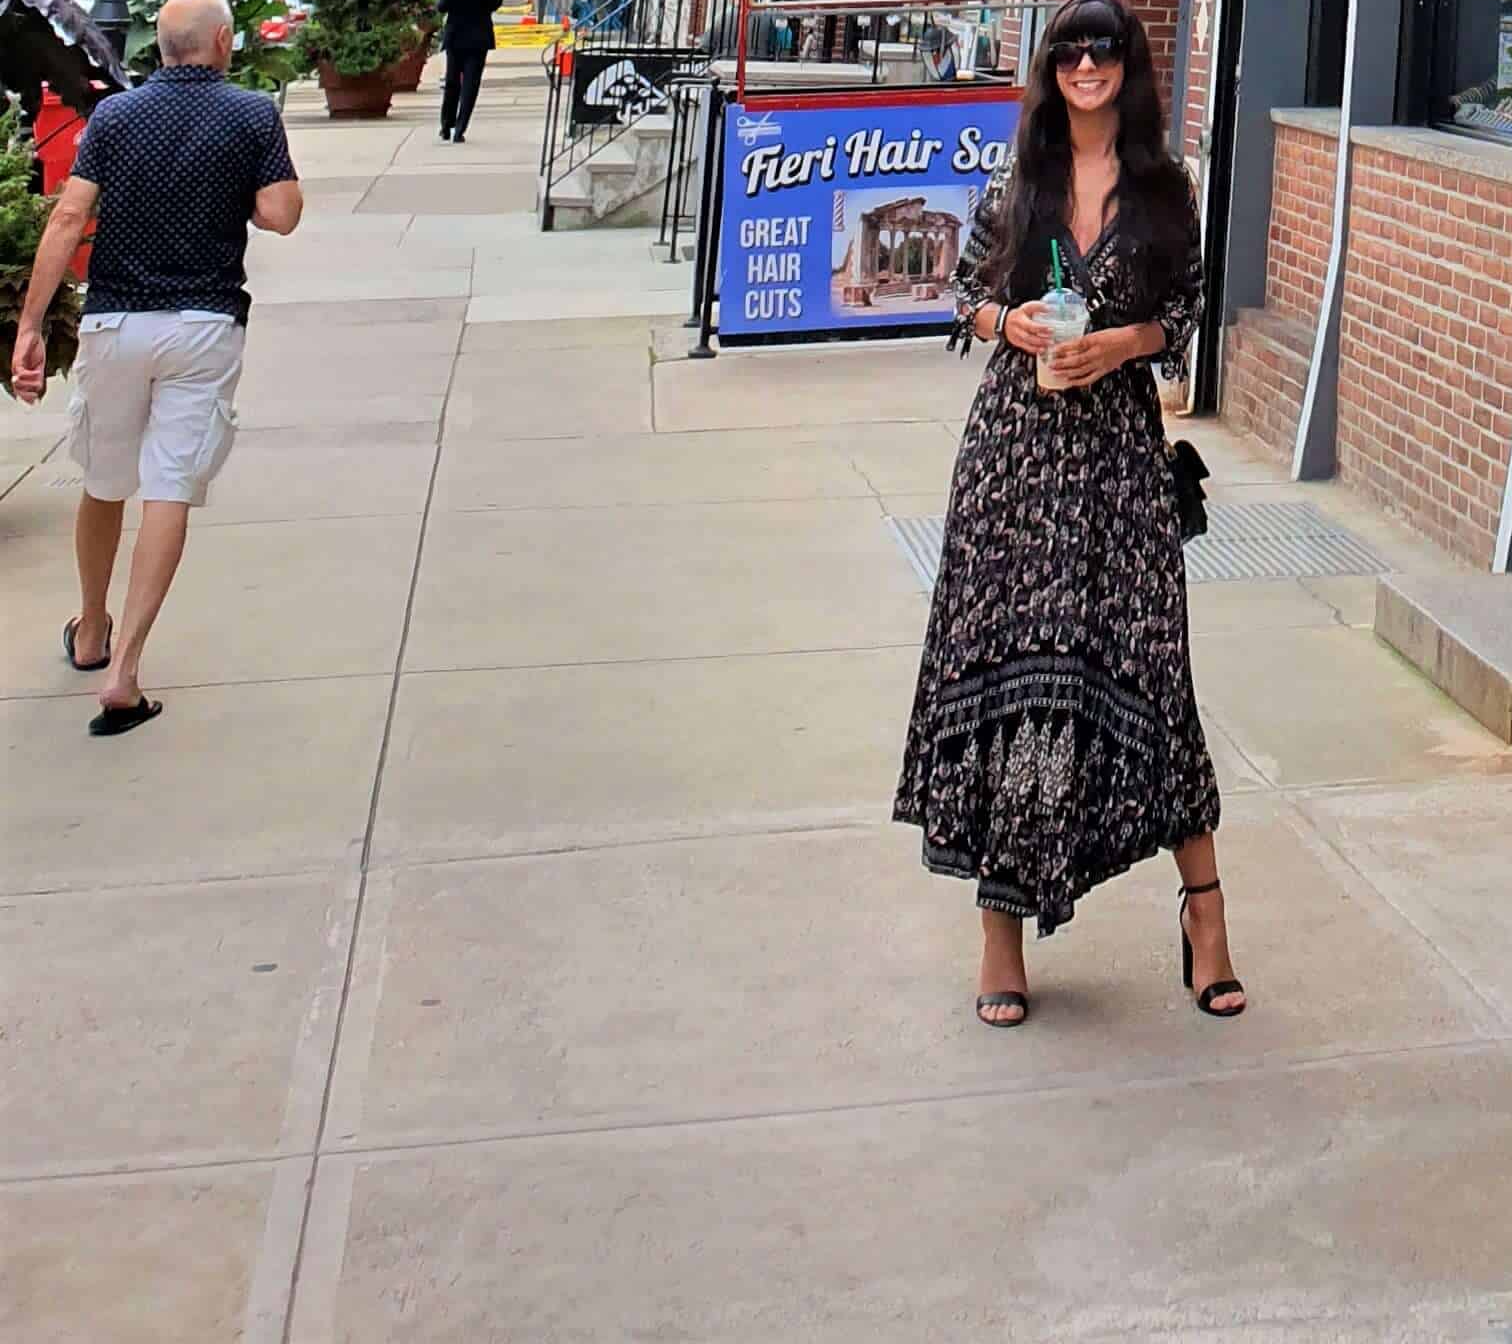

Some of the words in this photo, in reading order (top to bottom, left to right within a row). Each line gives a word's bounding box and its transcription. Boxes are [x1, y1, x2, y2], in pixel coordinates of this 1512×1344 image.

[741, 135, 838, 196] Fieri
[844, 126, 943, 176] Hair
[739, 215, 812, 249] GREAT
[747, 252, 802, 284] HAIR
[744, 287, 802, 320] CUTS
